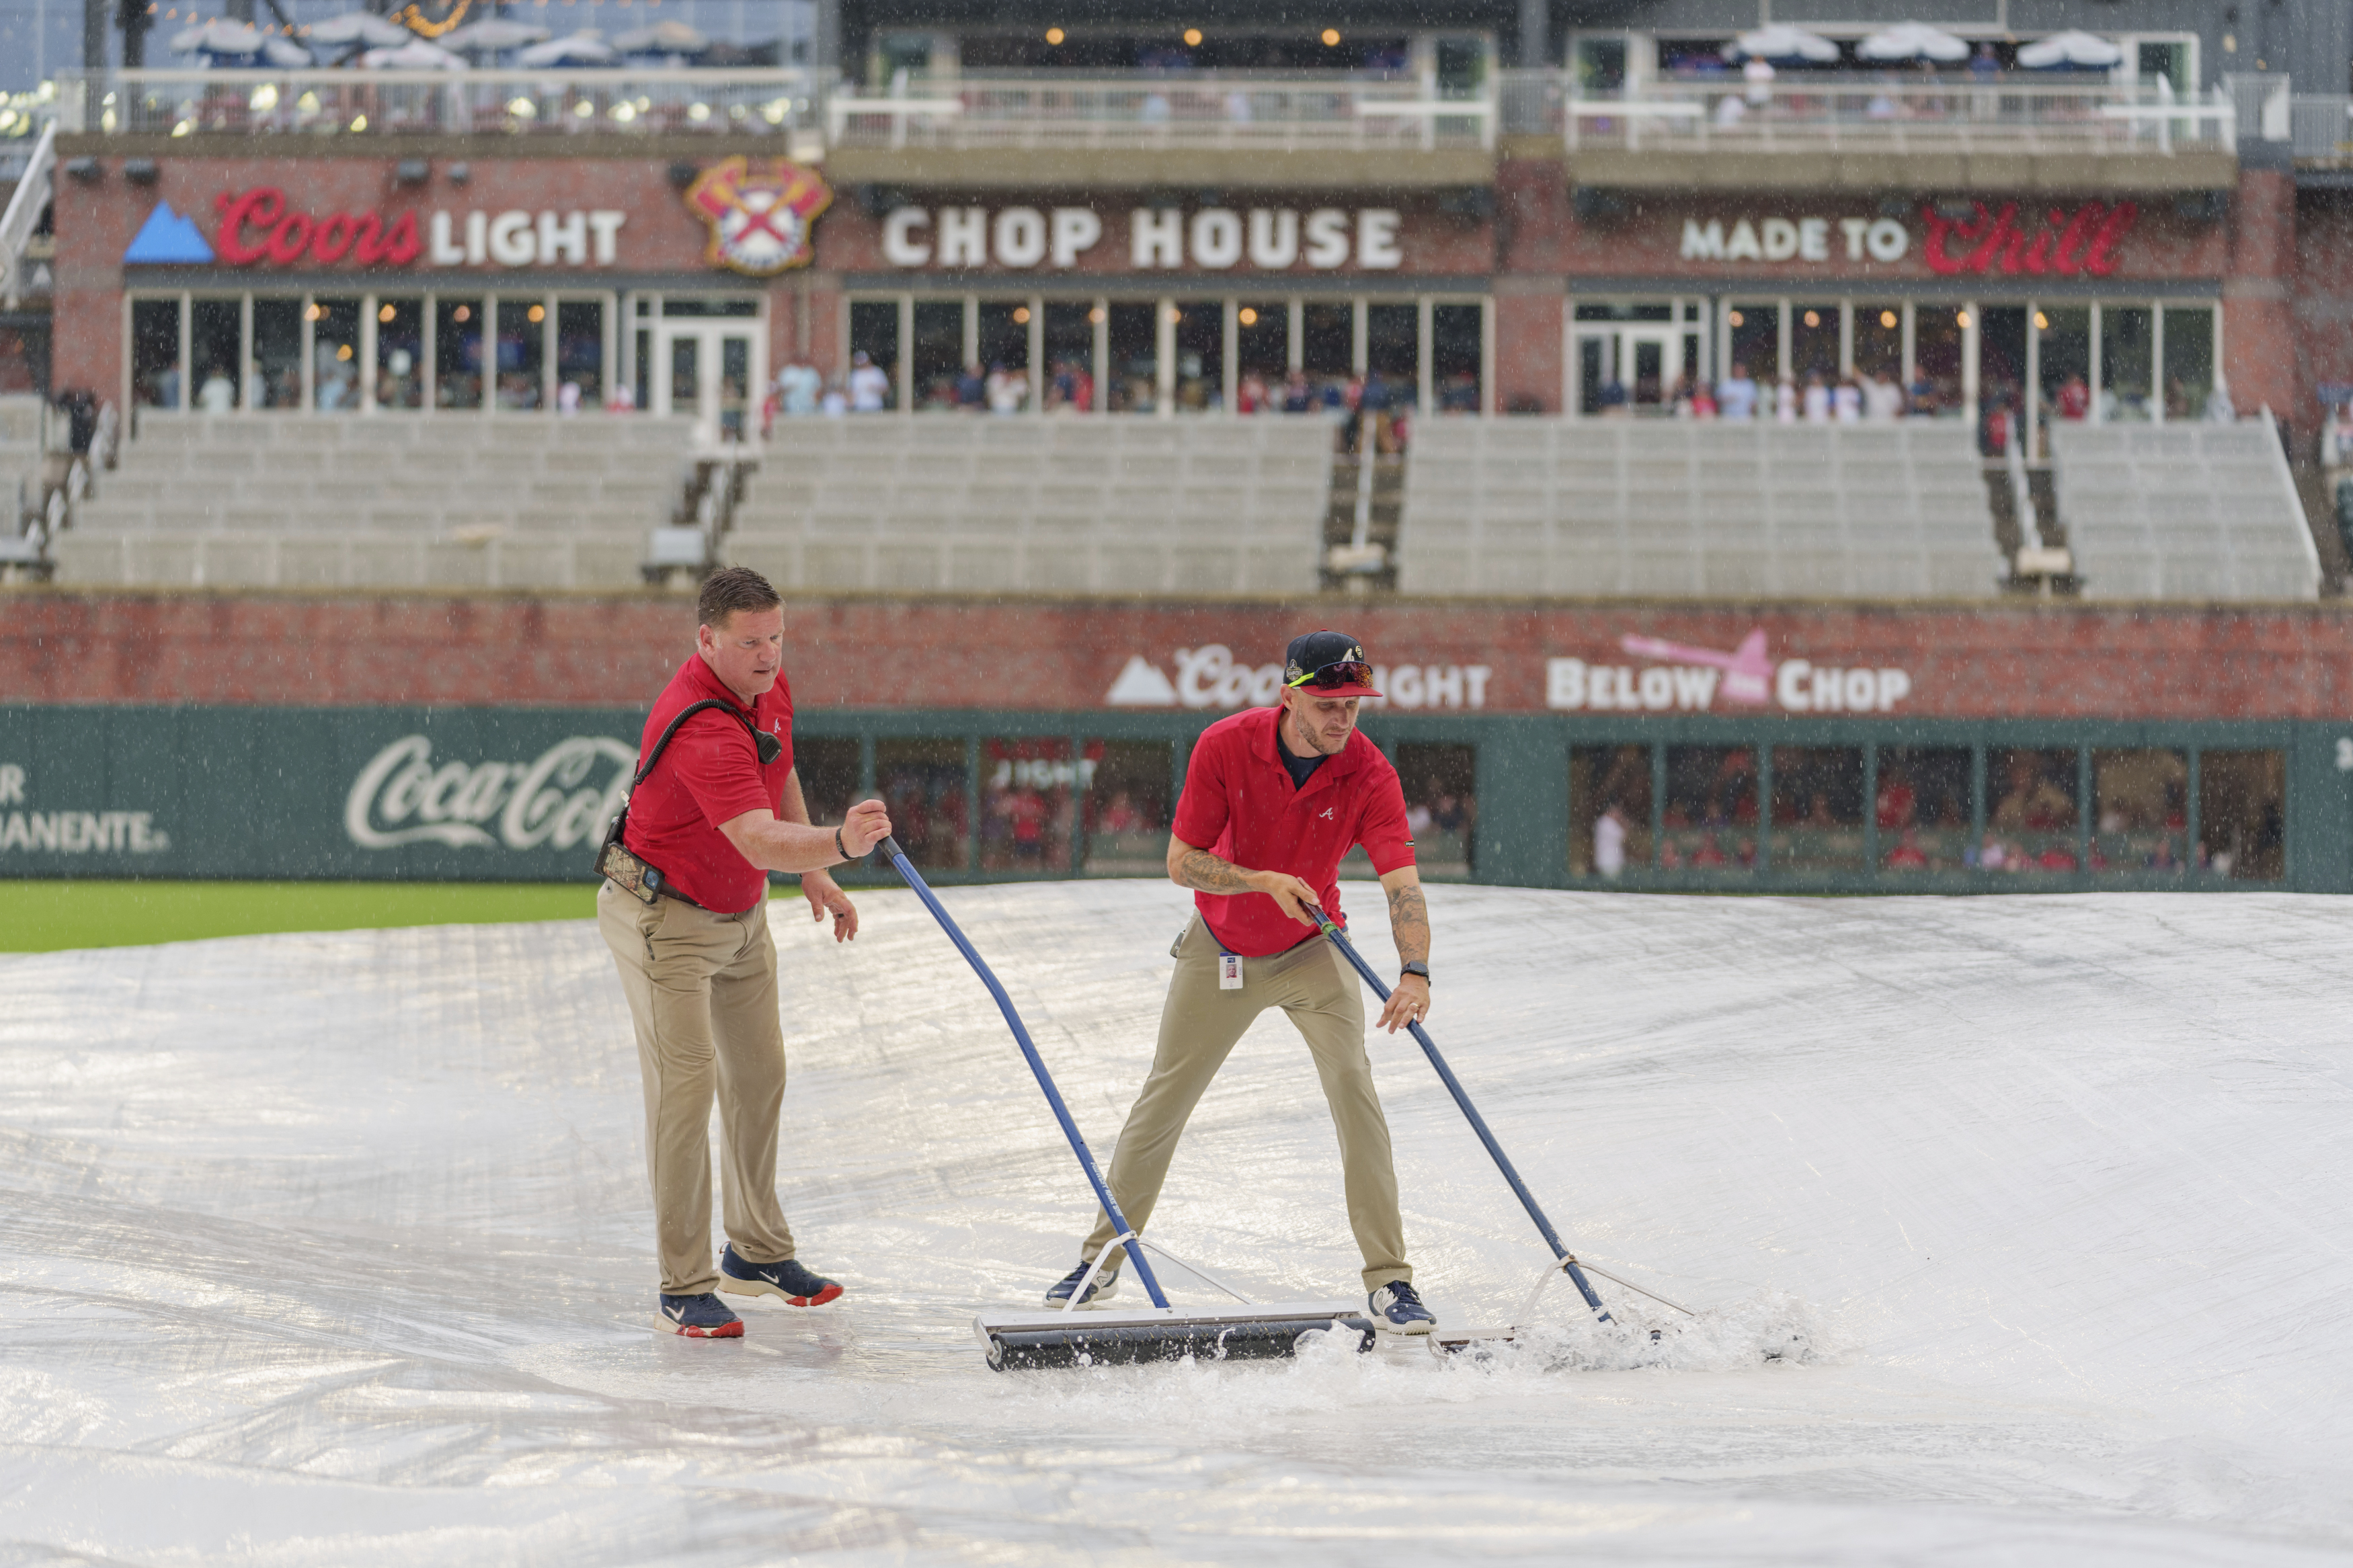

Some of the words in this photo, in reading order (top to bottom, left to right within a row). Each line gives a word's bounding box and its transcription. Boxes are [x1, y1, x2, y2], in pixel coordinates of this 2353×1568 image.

[216, 186, 424, 265] Coors
[430, 210, 626, 265] LIGHT
[882, 206, 1101, 267] CHOP
[1131, 207, 1405, 268] HOUSE
[1680, 217, 1831, 262] MADE
[1839, 217, 1909, 262] TO
[1921, 200, 2139, 276] Chill
[1174, 643, 1285, 708] Coo
[1359, 663, 1492, 709] IGHT
[1548, 657, 1718, 710] BELOW
[1776, 658, 1911, 712] CHOP
[344, 734, 640, 851] Coca-Col
[1090, 1161, 1109, 1188] MIDWEST
[1105, 1189, 1117, 1205] RAKE
